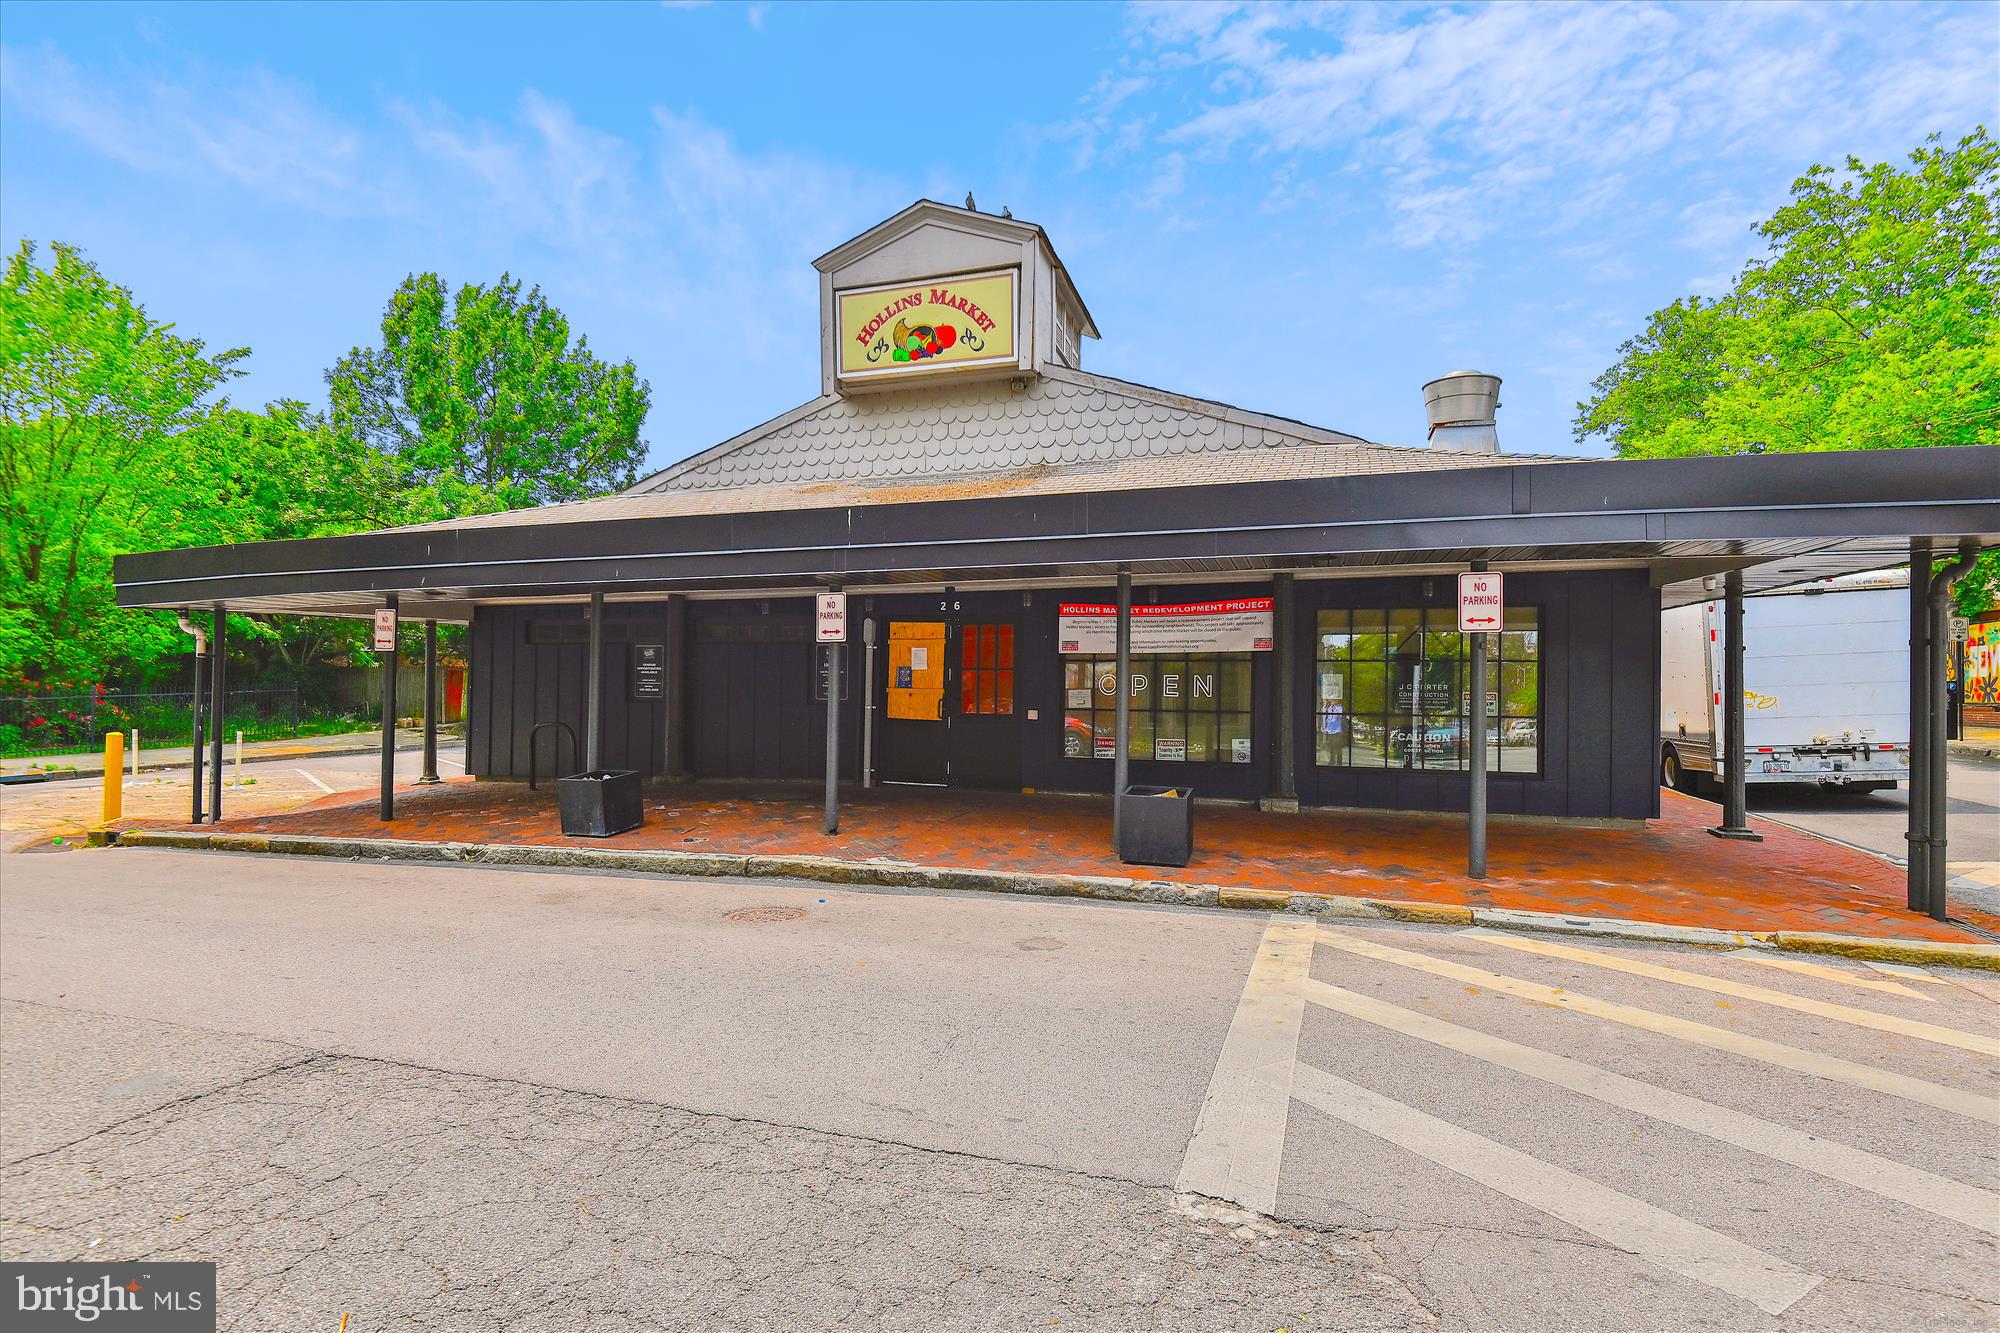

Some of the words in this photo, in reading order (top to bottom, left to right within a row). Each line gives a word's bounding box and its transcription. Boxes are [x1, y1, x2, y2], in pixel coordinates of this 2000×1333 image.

[856, 292, 923, 347] HOLLINS
[928, 289, 997, 333] MARKET
[1473, 582, 1487, 592] NO
[826, 601, 836, 609] NO
[1463, 595, 1498, 605] PARKING
[1142, 604, 1223, 614] REDEVELOPMENT
[1226, 600, 1270, 610] PROJECT
[820, 612, 843, 620] PARKING
[1098, 674, 1213, 697] OPEN
